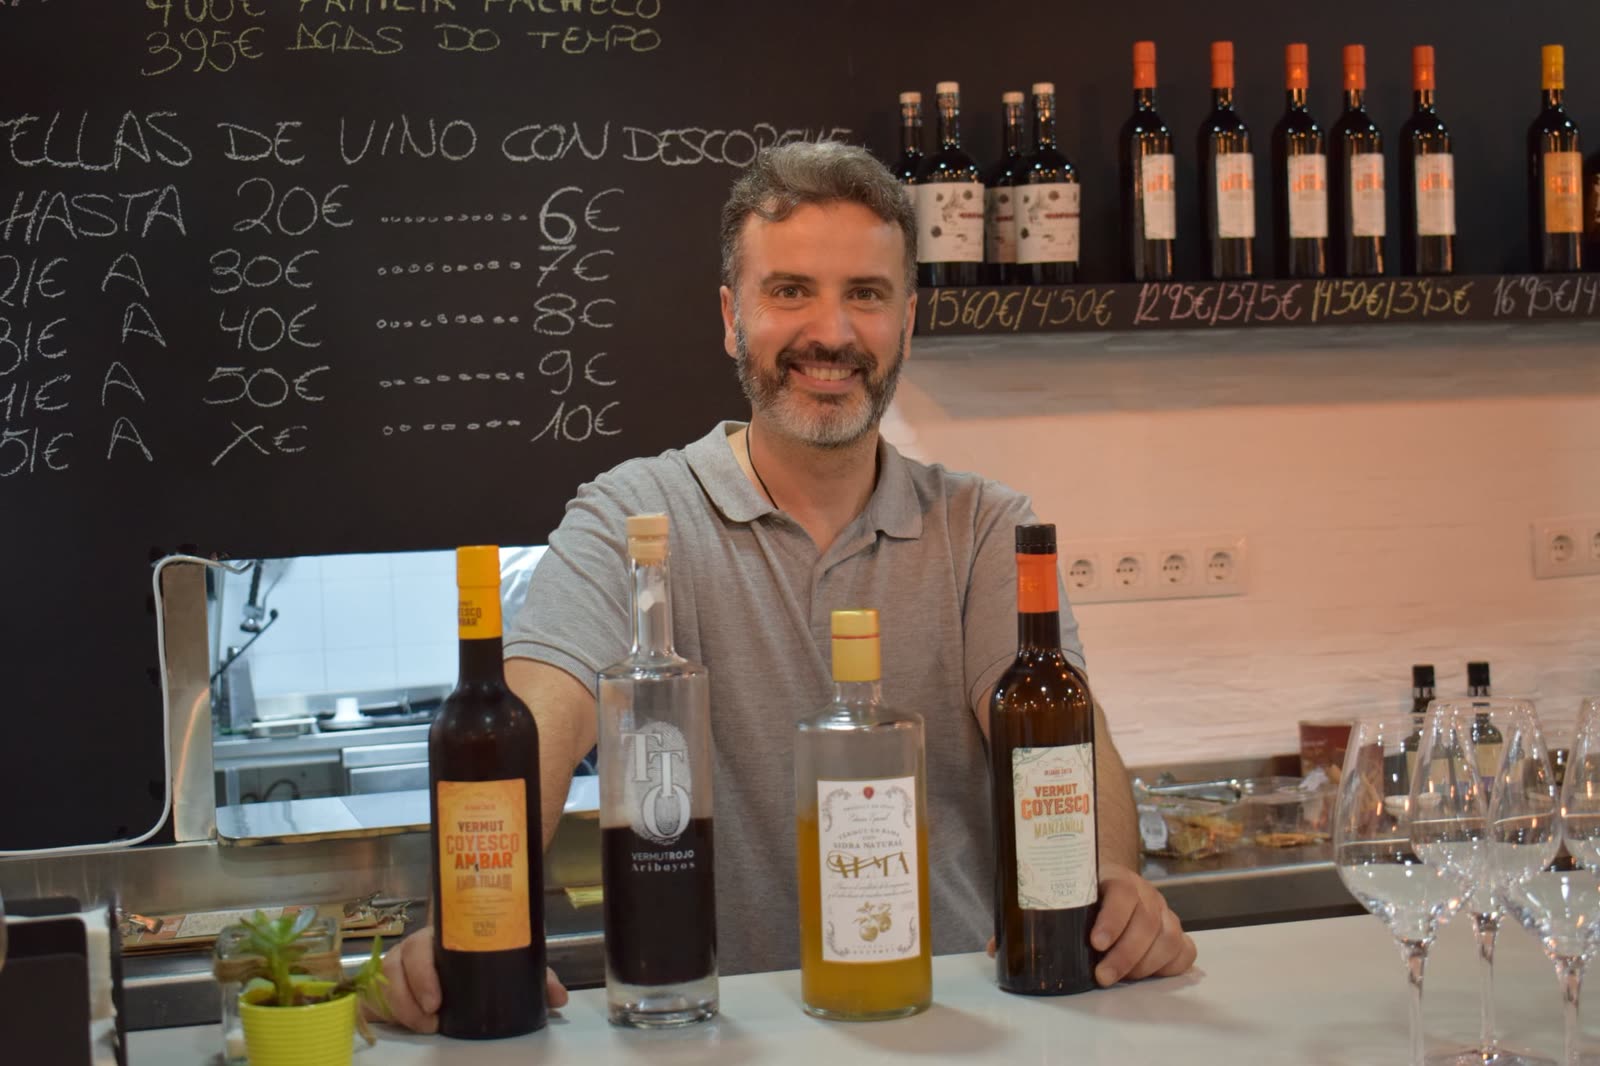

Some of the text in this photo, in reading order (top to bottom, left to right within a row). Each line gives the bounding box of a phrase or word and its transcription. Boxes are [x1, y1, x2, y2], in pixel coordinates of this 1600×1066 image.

[434, 23, 500, 51] DO
[217, 120, 305, 165] DE
[339, 114, 477, 165] VINO
[501, 121, 609, 162] CON
[0, 178, 624, 244] HASTA 20€ 6€
[101, 253, 150, 297] A
[209, 249, 320, 294] 30€
[537, 245, 615, 287] 7€
[122, 303, 166, 347] A
[219, 304, 322, 351] 40€
[533, 294, 617, 336] 8€
[102, 361, 145, 406] A
[202, 366, 331, 408] 50€
[538, 350, 617, 395] 9€
[107, 417, 153, 462] A
[530, 401, 622, 442] 10€
[1034, 783, 1078, 798] VERMUT
[457, 820, 504, 833] VERMUT
[454, 852, 513, 871] AMBAR
